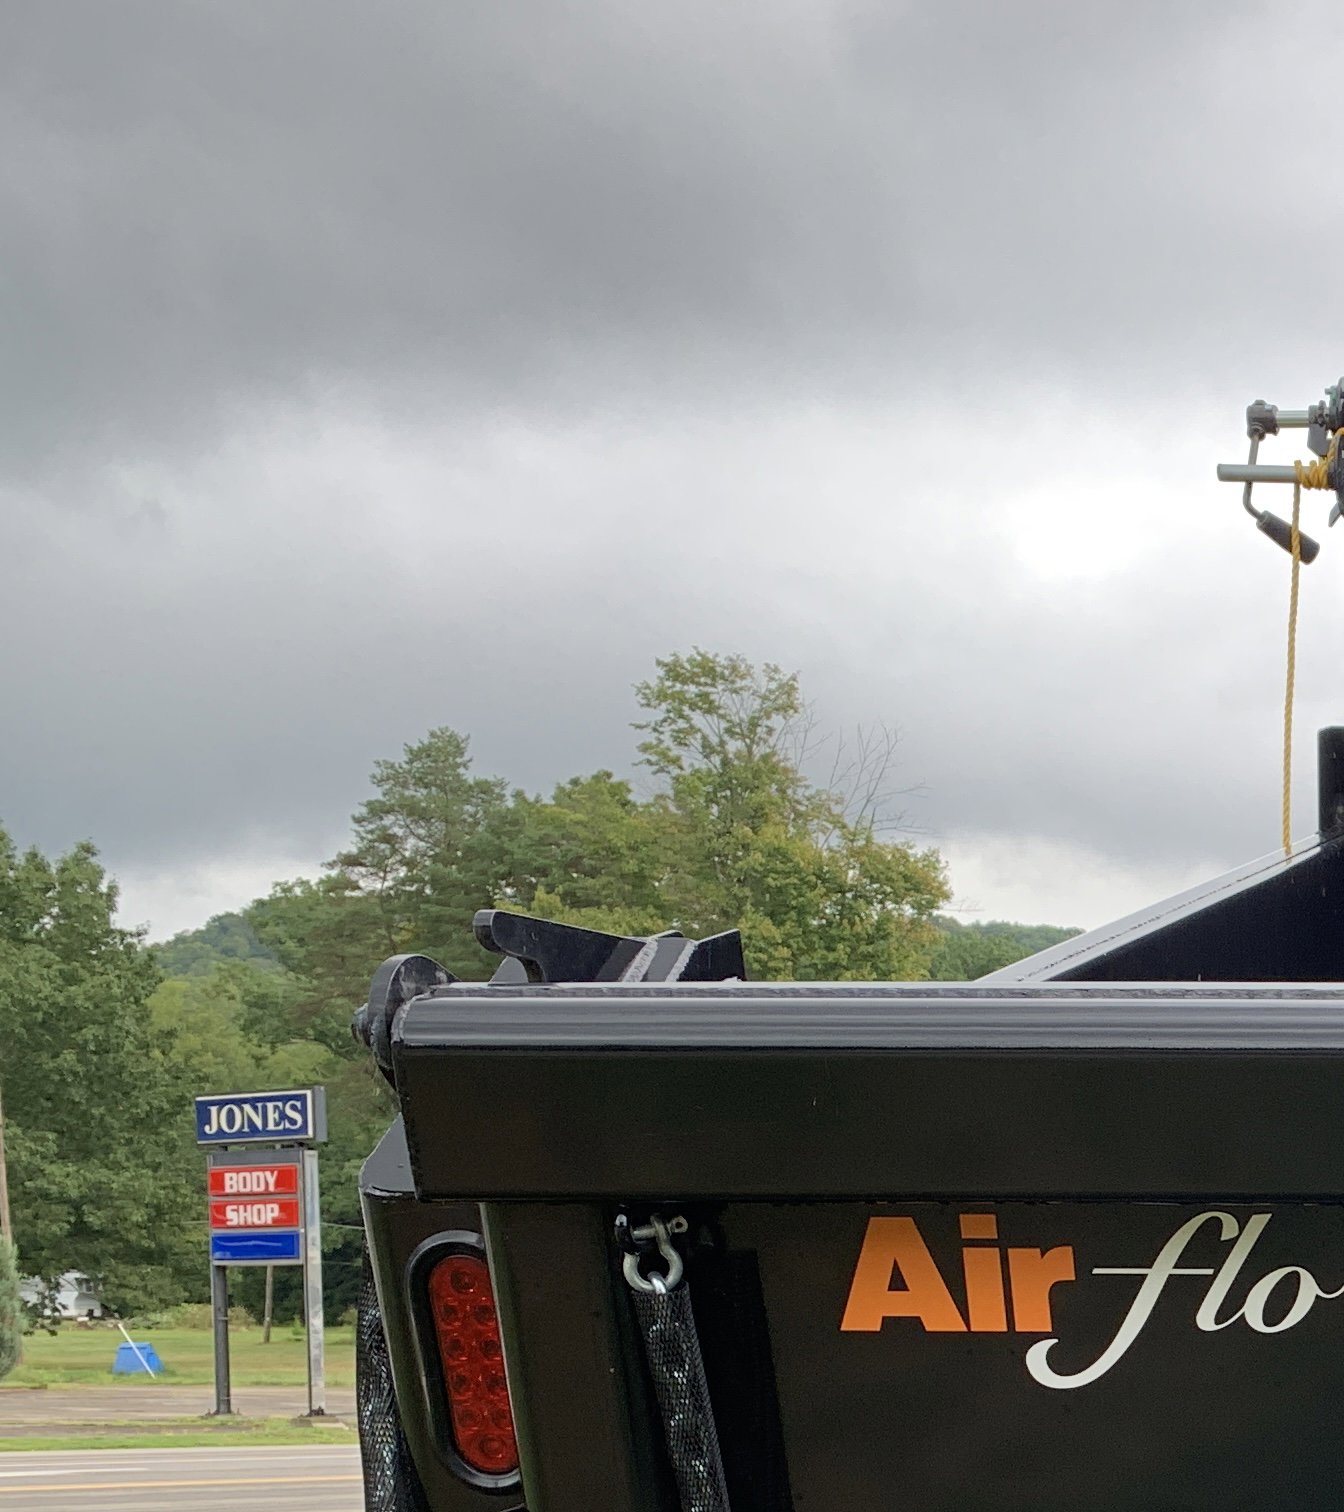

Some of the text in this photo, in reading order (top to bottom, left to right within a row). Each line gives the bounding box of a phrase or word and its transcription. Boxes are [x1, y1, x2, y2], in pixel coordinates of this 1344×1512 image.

[204, 1100, 303, 1135] JONES
[224, 1170, 278, 1194] BODY
[225, 1203, 280, 1227] SHOP
